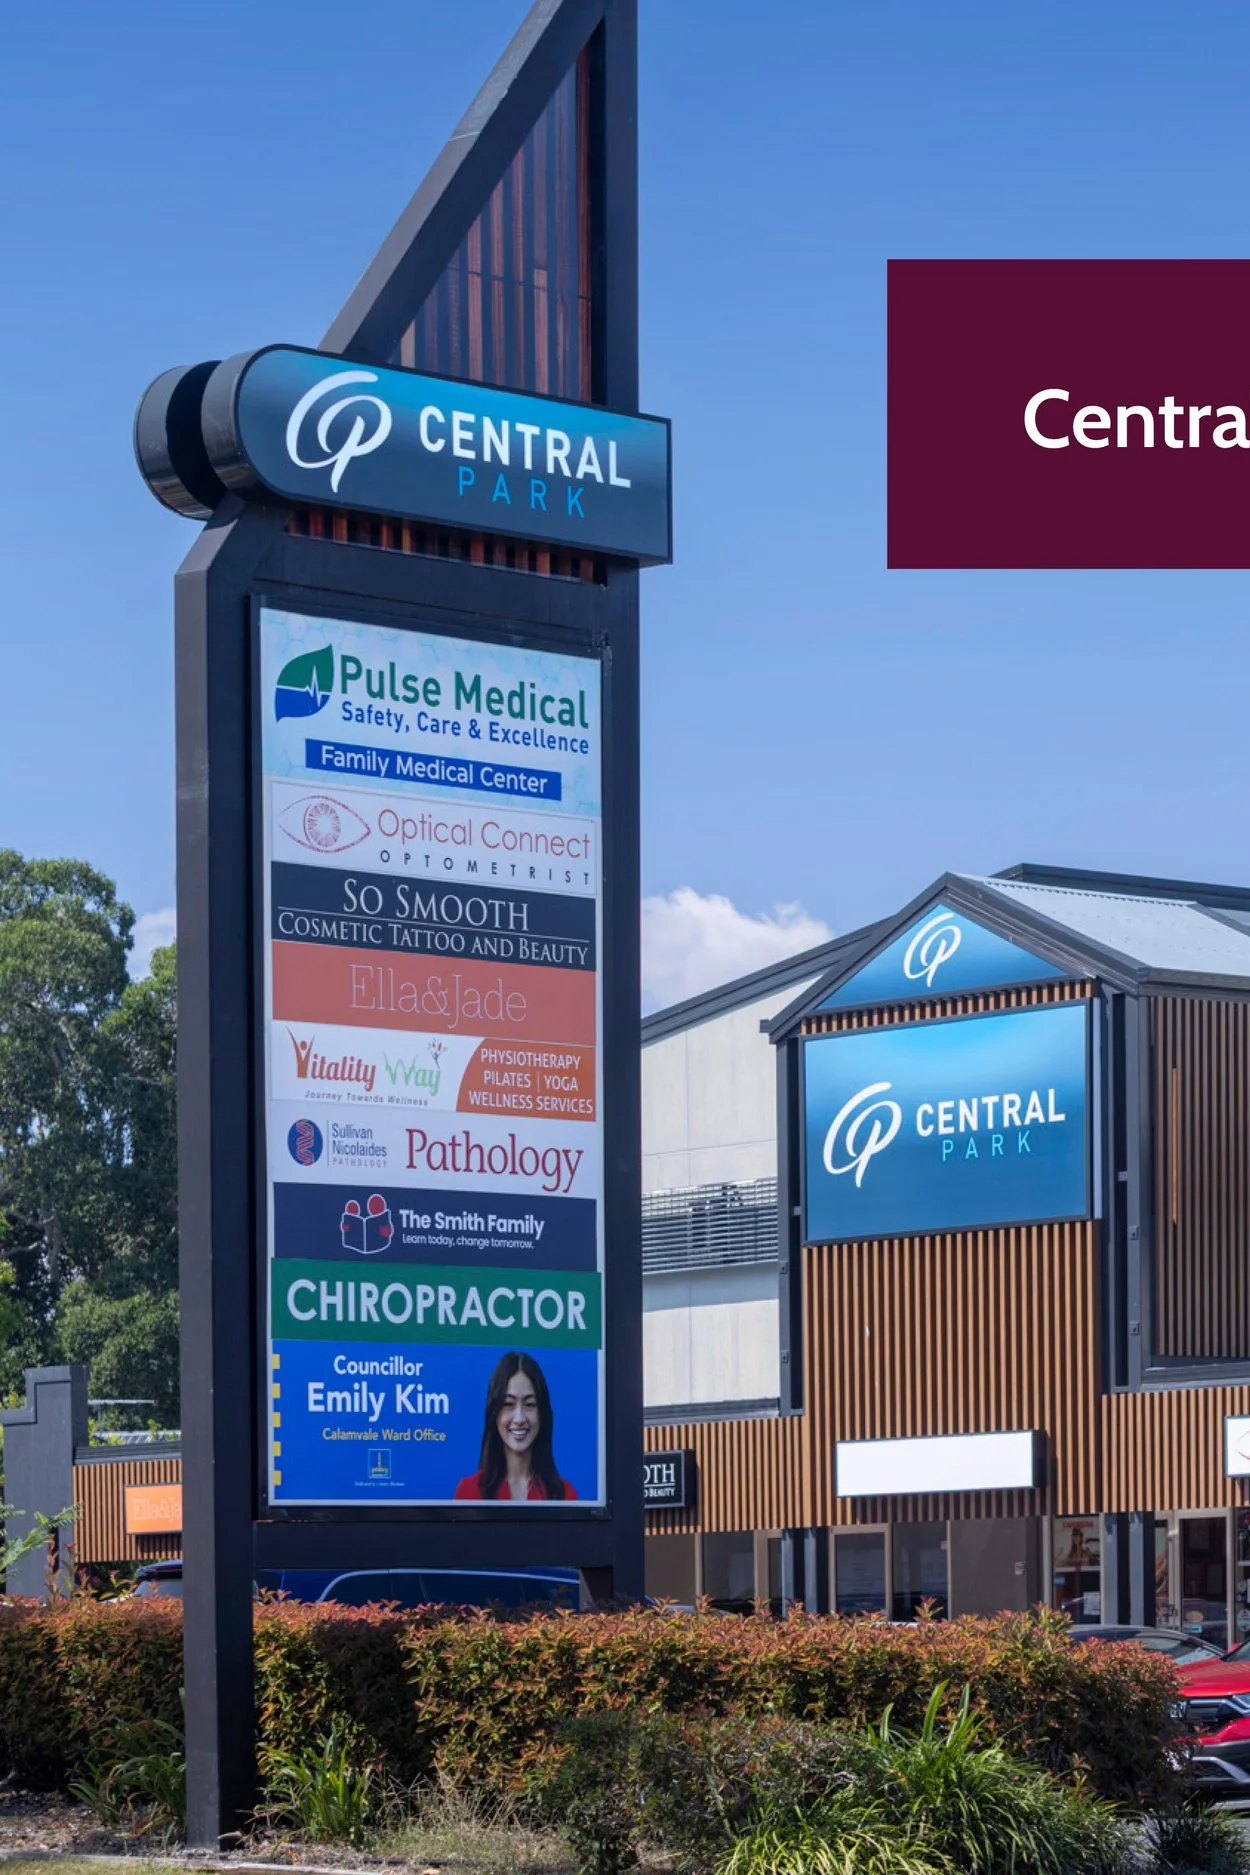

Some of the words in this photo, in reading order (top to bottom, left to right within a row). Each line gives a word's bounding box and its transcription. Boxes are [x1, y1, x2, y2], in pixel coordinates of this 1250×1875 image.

[418, 404, 631, 488] CENTRAL
[458, 465, 586, 518] PARK
[340, 654, 442, 707] Pulse
[454, 671, 589, 729] Medical
[342, 701, 410, 733] Safety,
[417, 712, 461, 736] Care
[469, 719, 482, 740] &
[488, 721, 589, 754] Excellence
[321, 745, 389, 776] Family
[396, 755, 473, 784] Medical
[480, 766, 548, 793] Center
[378, 808, 472, 845] Optical
[480, 821, 590, 859] Connect
[380, 850, 589, 885] OPTOMETRIST
[343, 878, 383, 915] SO
[396, 884, 529, 931] SMOOTH
[278, 911, 382, 944] COSMETIC
[388, 923, 465, 954] TATTOO
[471, 936, 513, 958] AND
[519, 938, 588, 965] BEAUTY
[349, 964, 527, 1029] Ella&Jade
[285, 1025, 376, 1092] Vitality
[383, 1050, 441, 1096] Way
[480, 1048, 581, 1070] PHYSIOTHERAPY
[484, 1070, 531, 1088] PILATES
[544, 1075, 579, 1091] YOGA
[305, 1090, 342, 1101] Journey
[347, 1092, 384, 1103] Towards
[388, 1096, 429, 1106] Wellness
[469, 1090, 533, 1109] WELLNESS
[536, 1095, 593, 1114] SERVICES
[916, 1088, 1066, 1137] CENTRAL
[332, 1122, 373, 1139] Sullivan
[333, 1140, 387, 1157] Nicolaides
[941, 1131, 1031, 1161] PARK
[405, 1128, 584, 1194] Pathology
[399, 1209, 431, 1229] The
[434, 1211, 485, 1232] Smith
[488, 1214, 545, 1241] Family
[402, 1233, 426, 1244] Learn
[428, 1234, 455, 1249] today,
[456, 1236, 489, 1249] change
[491, 1238, 535, 1249] tomorrow.
[287, 1278, 587, 1330] CHIROPRACTOR
[333, 1355, 423, 1377] Councillor
[308, 1381, 386, 1422] Emily
[396, 1383, 449, 1415] Kim
[322, 1427, 379, 1442] Calamvale
[382, 1428, 411, 1442] Ward
[413, 1428, 446, 1442] Office
